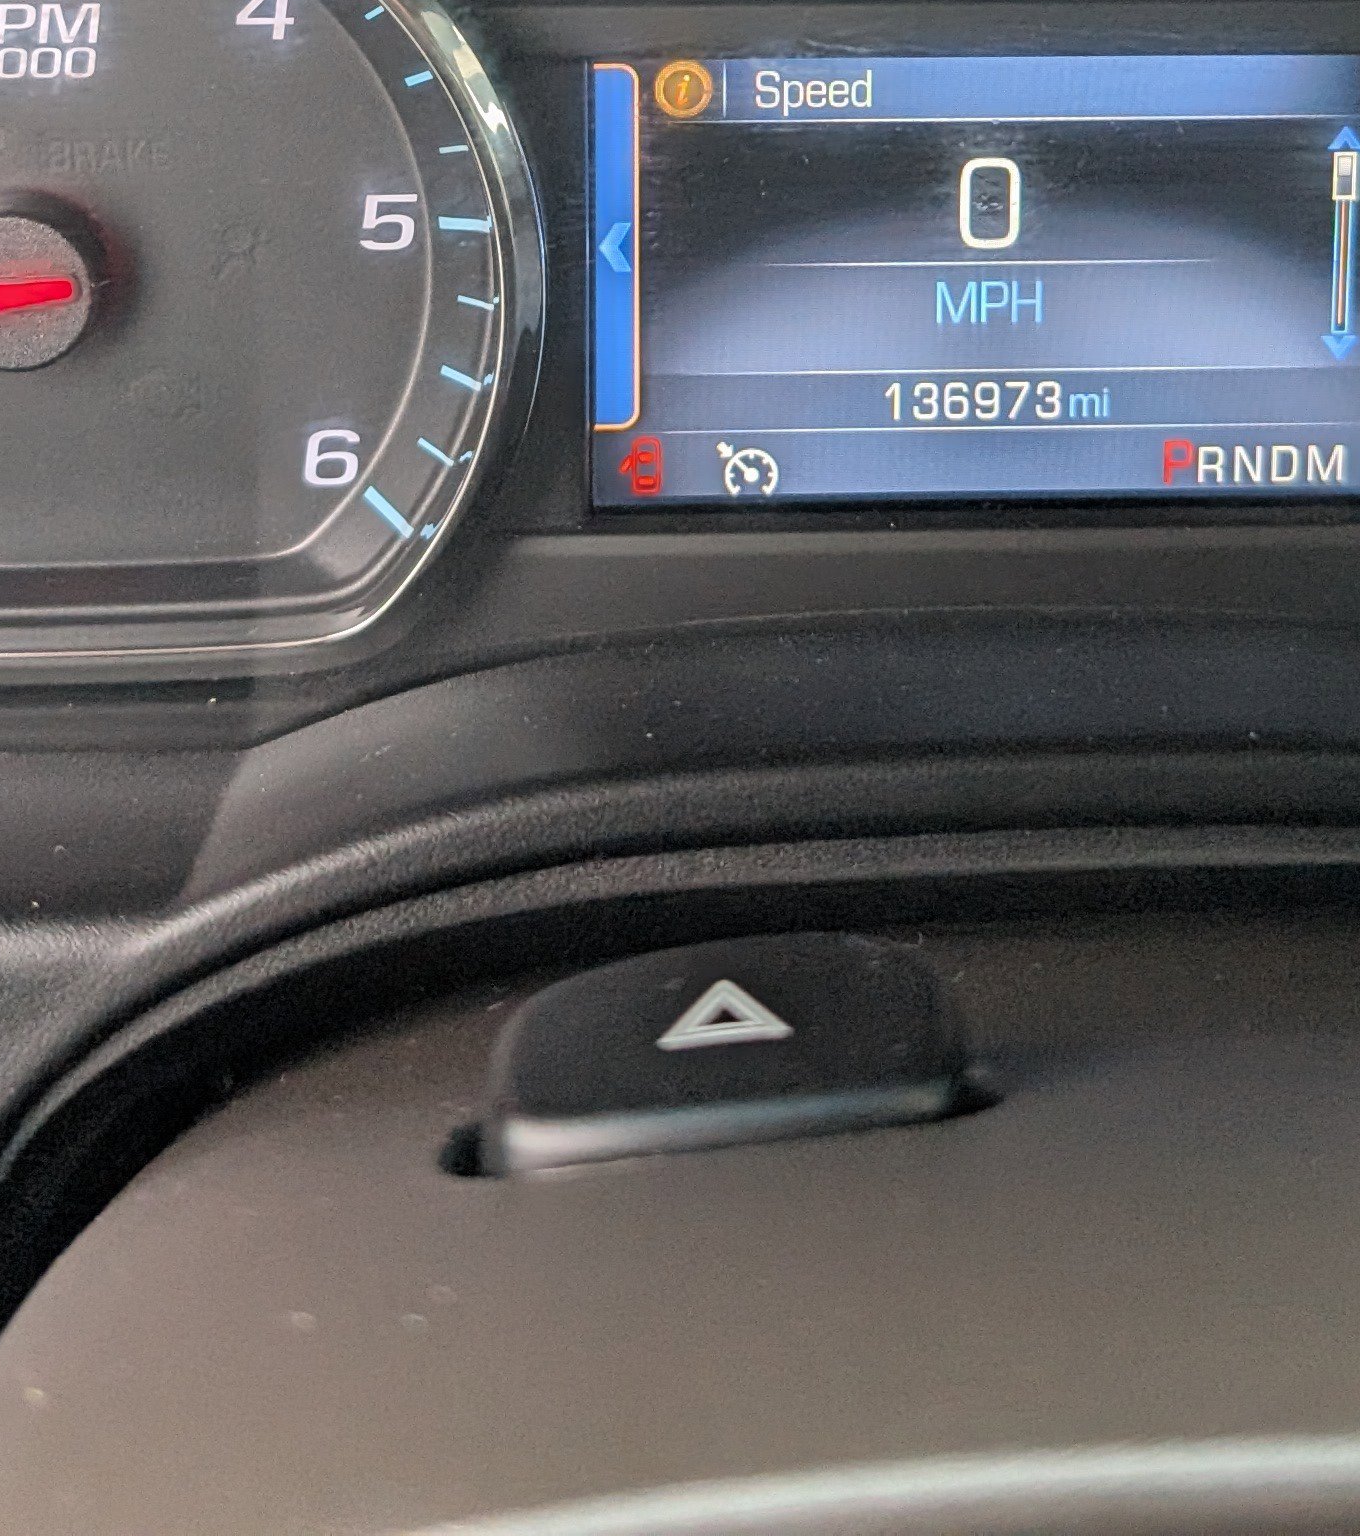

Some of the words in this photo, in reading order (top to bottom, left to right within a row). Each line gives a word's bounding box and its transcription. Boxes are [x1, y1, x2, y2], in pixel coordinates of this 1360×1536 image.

[755, 70, 873, 117] Speed
[360, 193, 418, 251] 5
[959, 157, 1021, 249] 0
[935, 281, 1044, 324] MPH
[304, 429, 361, 486] 6
